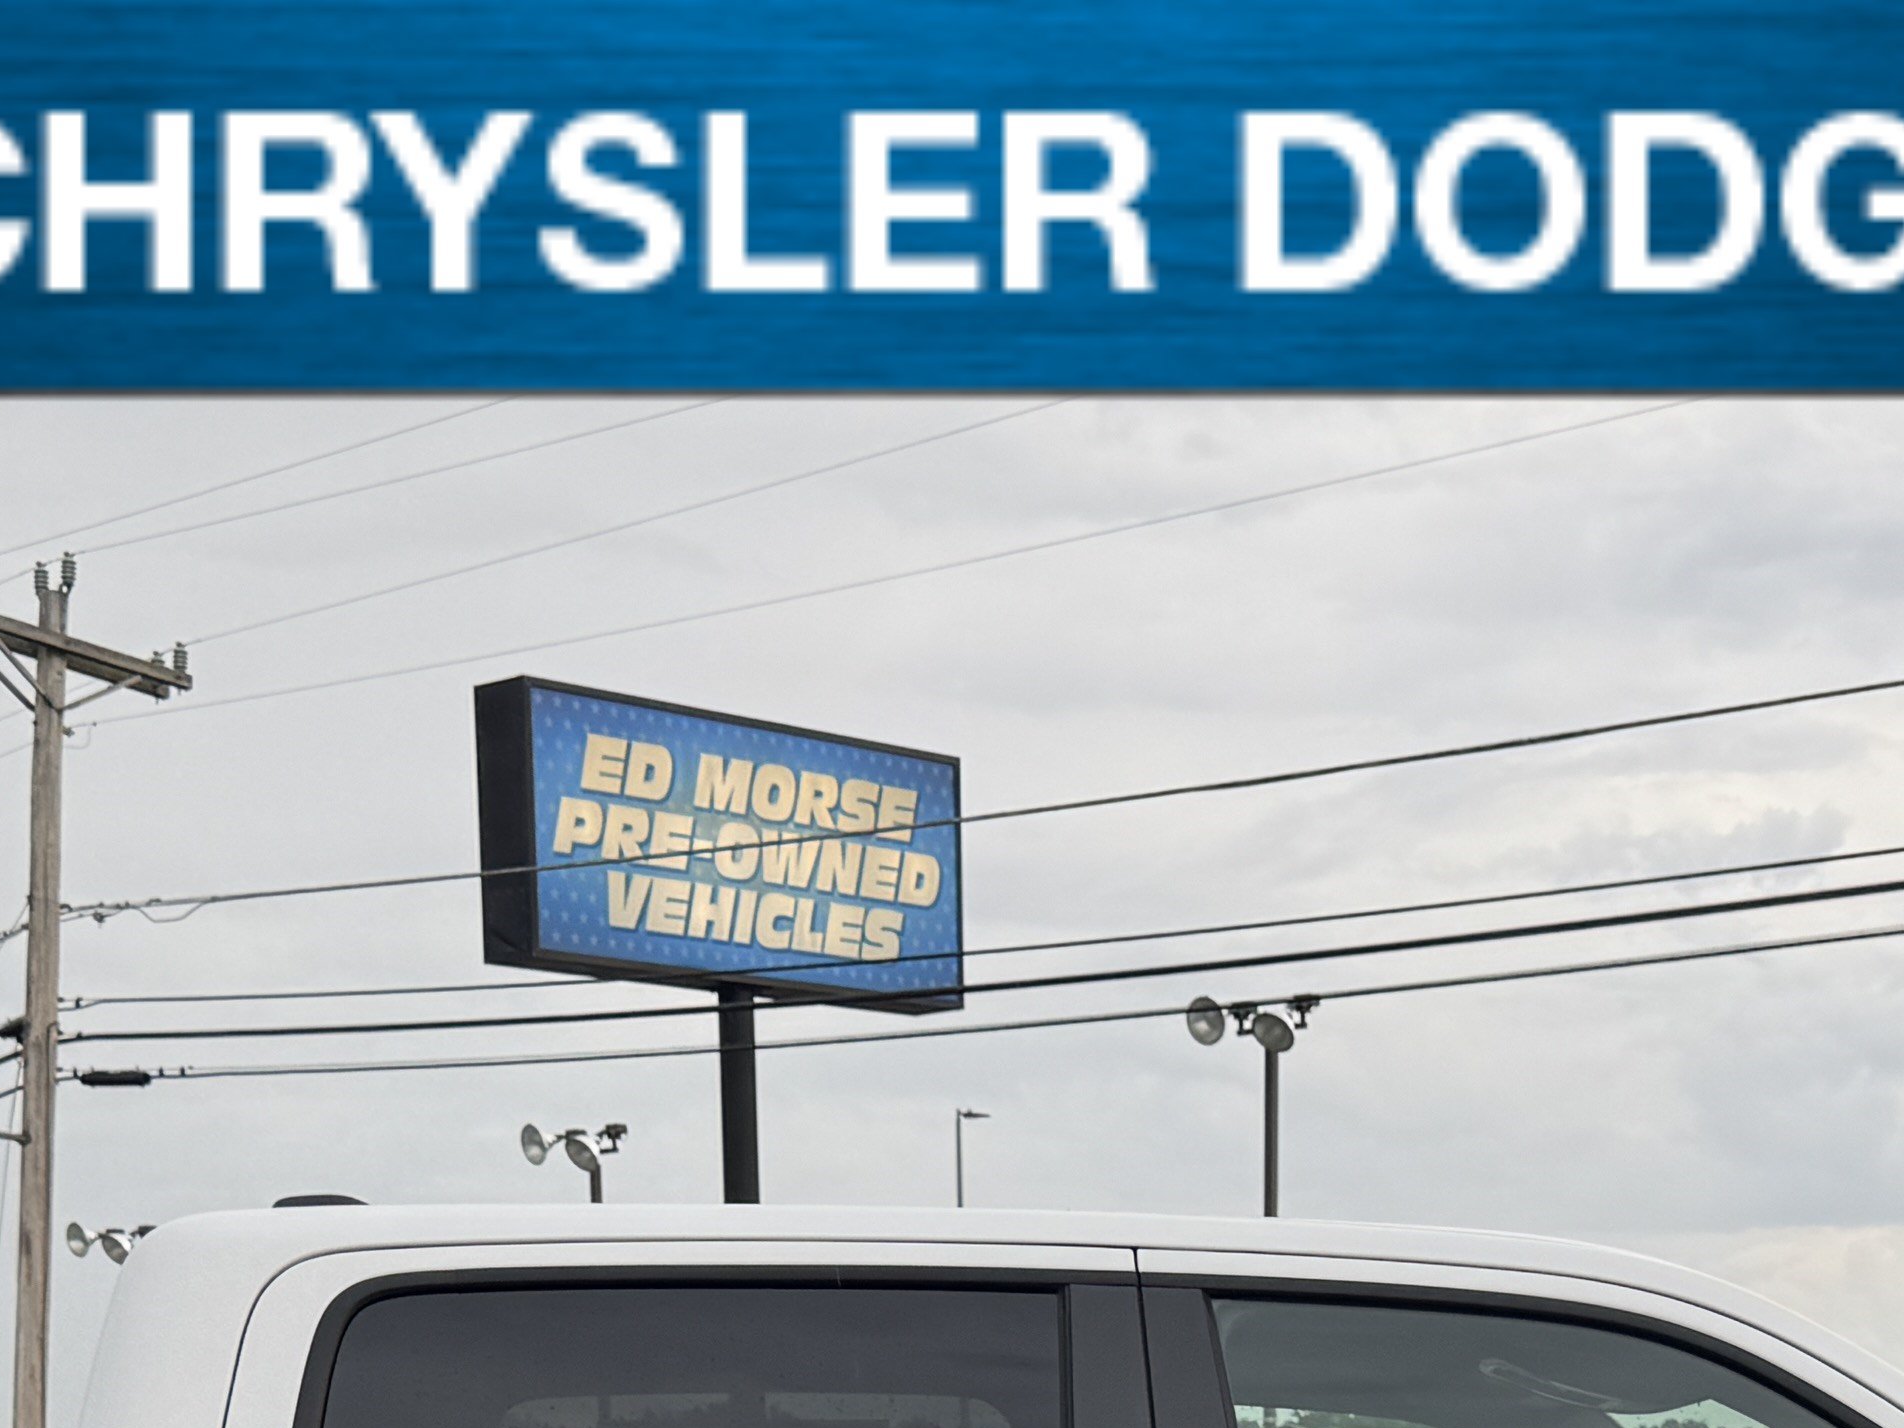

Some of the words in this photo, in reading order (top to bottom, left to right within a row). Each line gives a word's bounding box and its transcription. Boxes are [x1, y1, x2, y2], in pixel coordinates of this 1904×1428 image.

[580, 732, 673, 801] ED
[693, 752, 918, 842] MORSE
[552, 795, 941, 908] PRE-OWNED
[606, 869, 905, 961] VEHICLES
